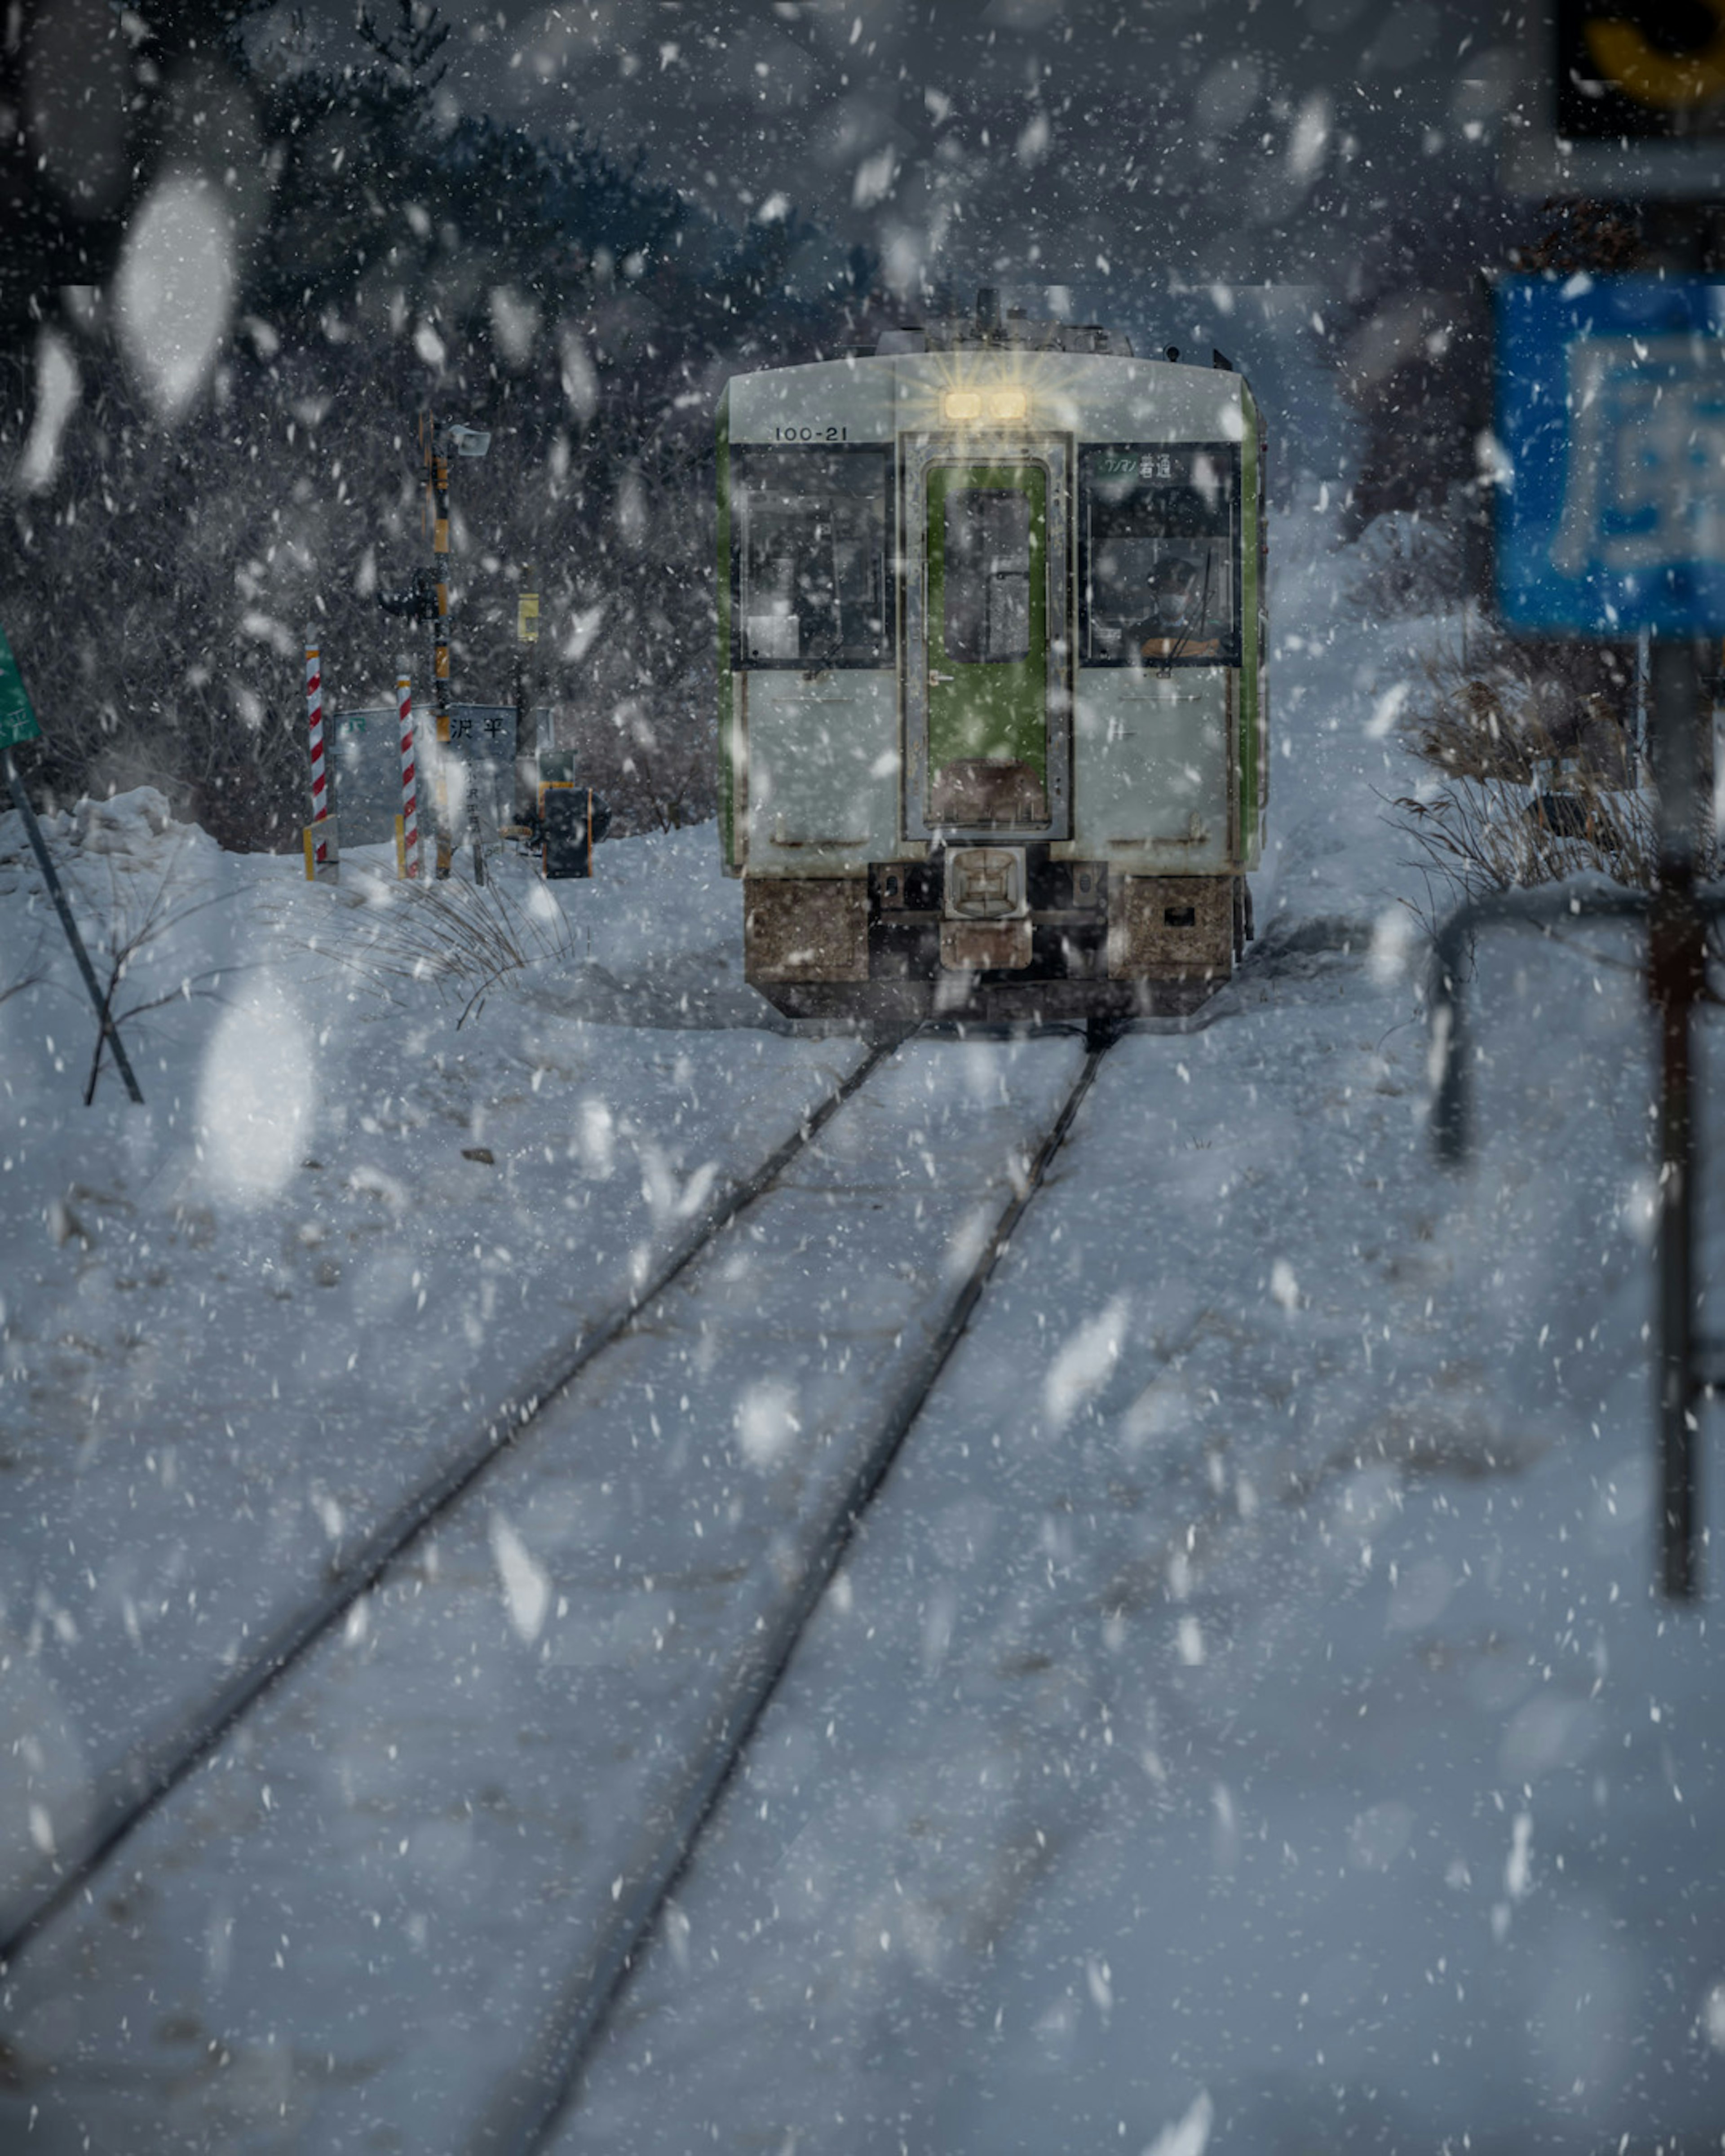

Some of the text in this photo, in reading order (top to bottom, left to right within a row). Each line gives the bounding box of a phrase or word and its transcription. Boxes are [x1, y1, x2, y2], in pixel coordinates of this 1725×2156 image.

[776, 427, 846, 441] 100-21
[1140, 453, 1171, 478] 普通
[345, 718, 366, 732] JR
